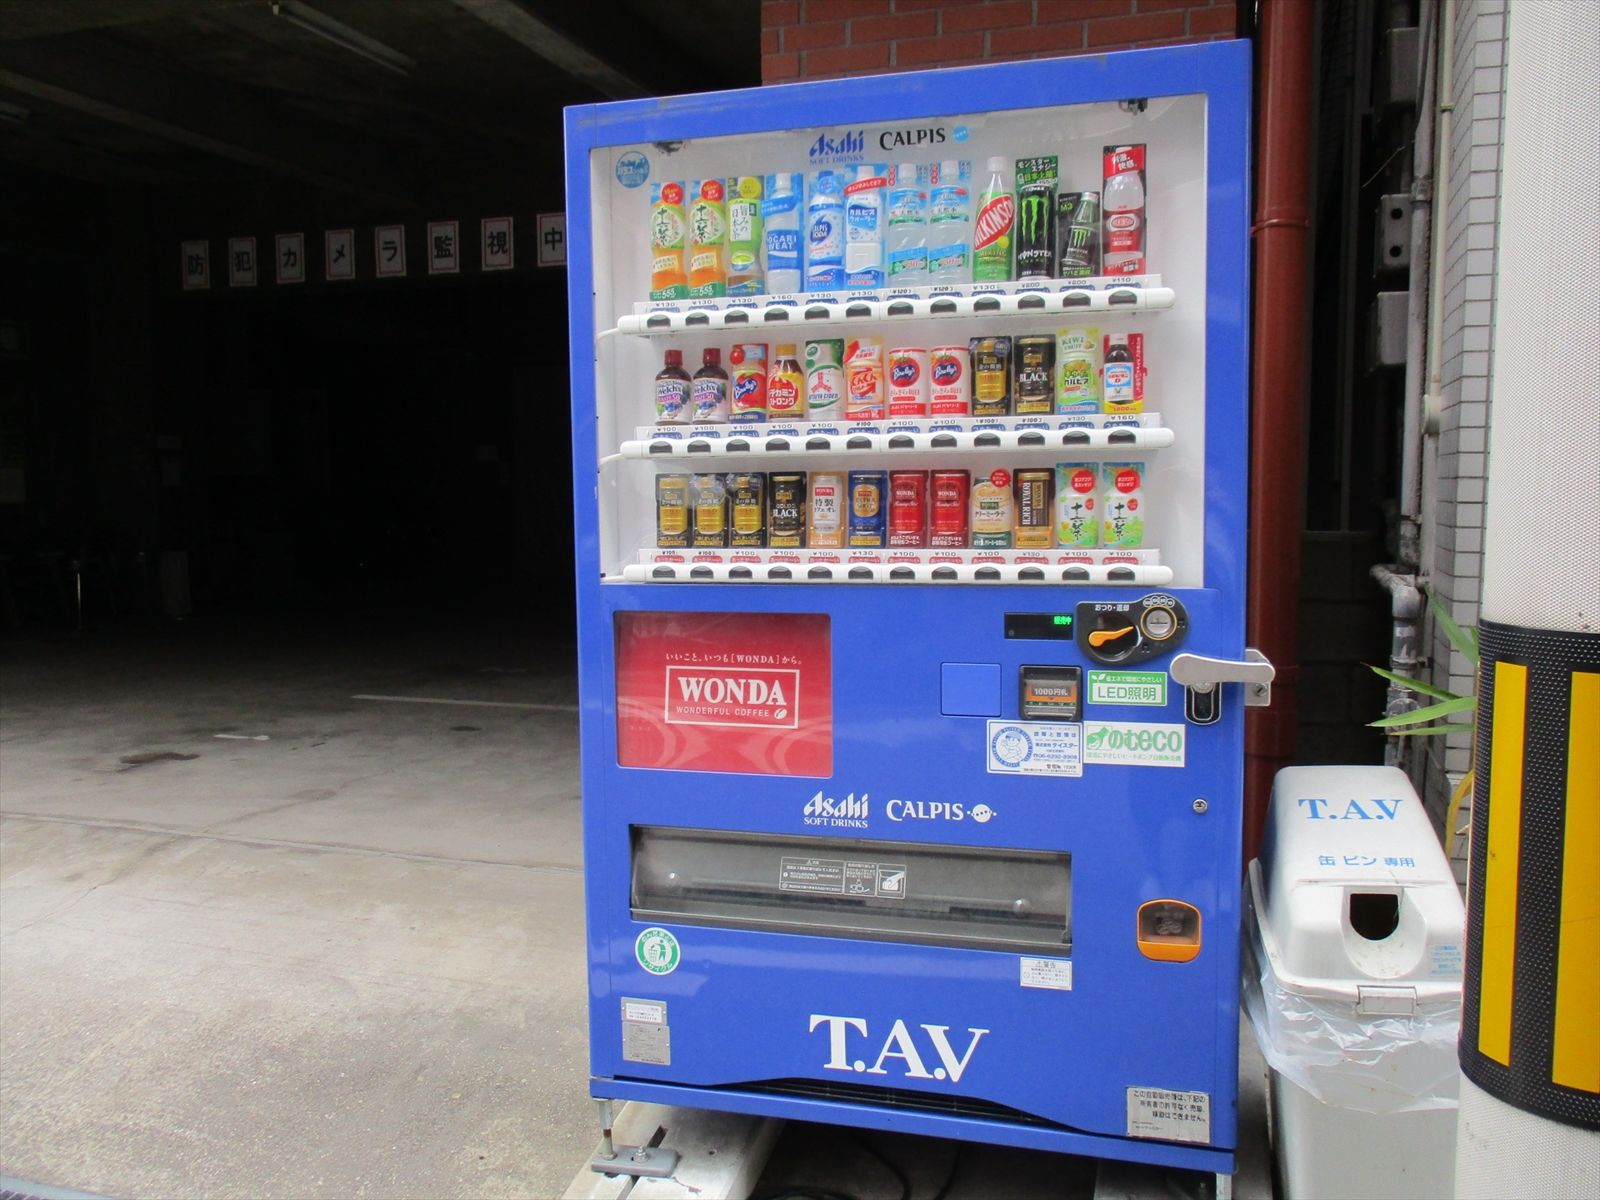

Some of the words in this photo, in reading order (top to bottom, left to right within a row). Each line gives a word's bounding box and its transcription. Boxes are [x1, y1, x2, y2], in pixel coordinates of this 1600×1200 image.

[809, 130, 864, 157] Asahi
[880, 128, 946, 151] CALPIS
[832, 155, 864, 164] DRINKS
[1062, 336, 1085, 346] KIWI
[1019, 372, 1048, 382] BLACK
[1022, 482, 1031, 506] ROYAL
[815, 498, 834, 507] 特製
[1022, 506, 1031, 525] RICH
[1094, 604, 1130, 612] おつり・返却
[1053, 615, 1072, 625] 販売中
[677, 676, 787, 706] WONDA
[1034, 687, 1068, 697] 1000円札
[1097, 686, 1157, 701] LED照明
[676, 706, 730, 716] WONDERFUL
[734, 708, 770, 717] COFFEE
[803, 790, 869, 819] Asahi
[886, 799, 964, 822] CALPIS
[1297, 798, 1403, 821] T.A.V
[803, 816, 830, 826] SOFT
[830, 818, 868, 829] DRINKS
[1318, 854, 1336, 867] 缶
[1343, 855, 1376, 866] ビン
[1384, 856, 1416, 868] 専用
[809, 1014, 990, 1083] T.A.V
